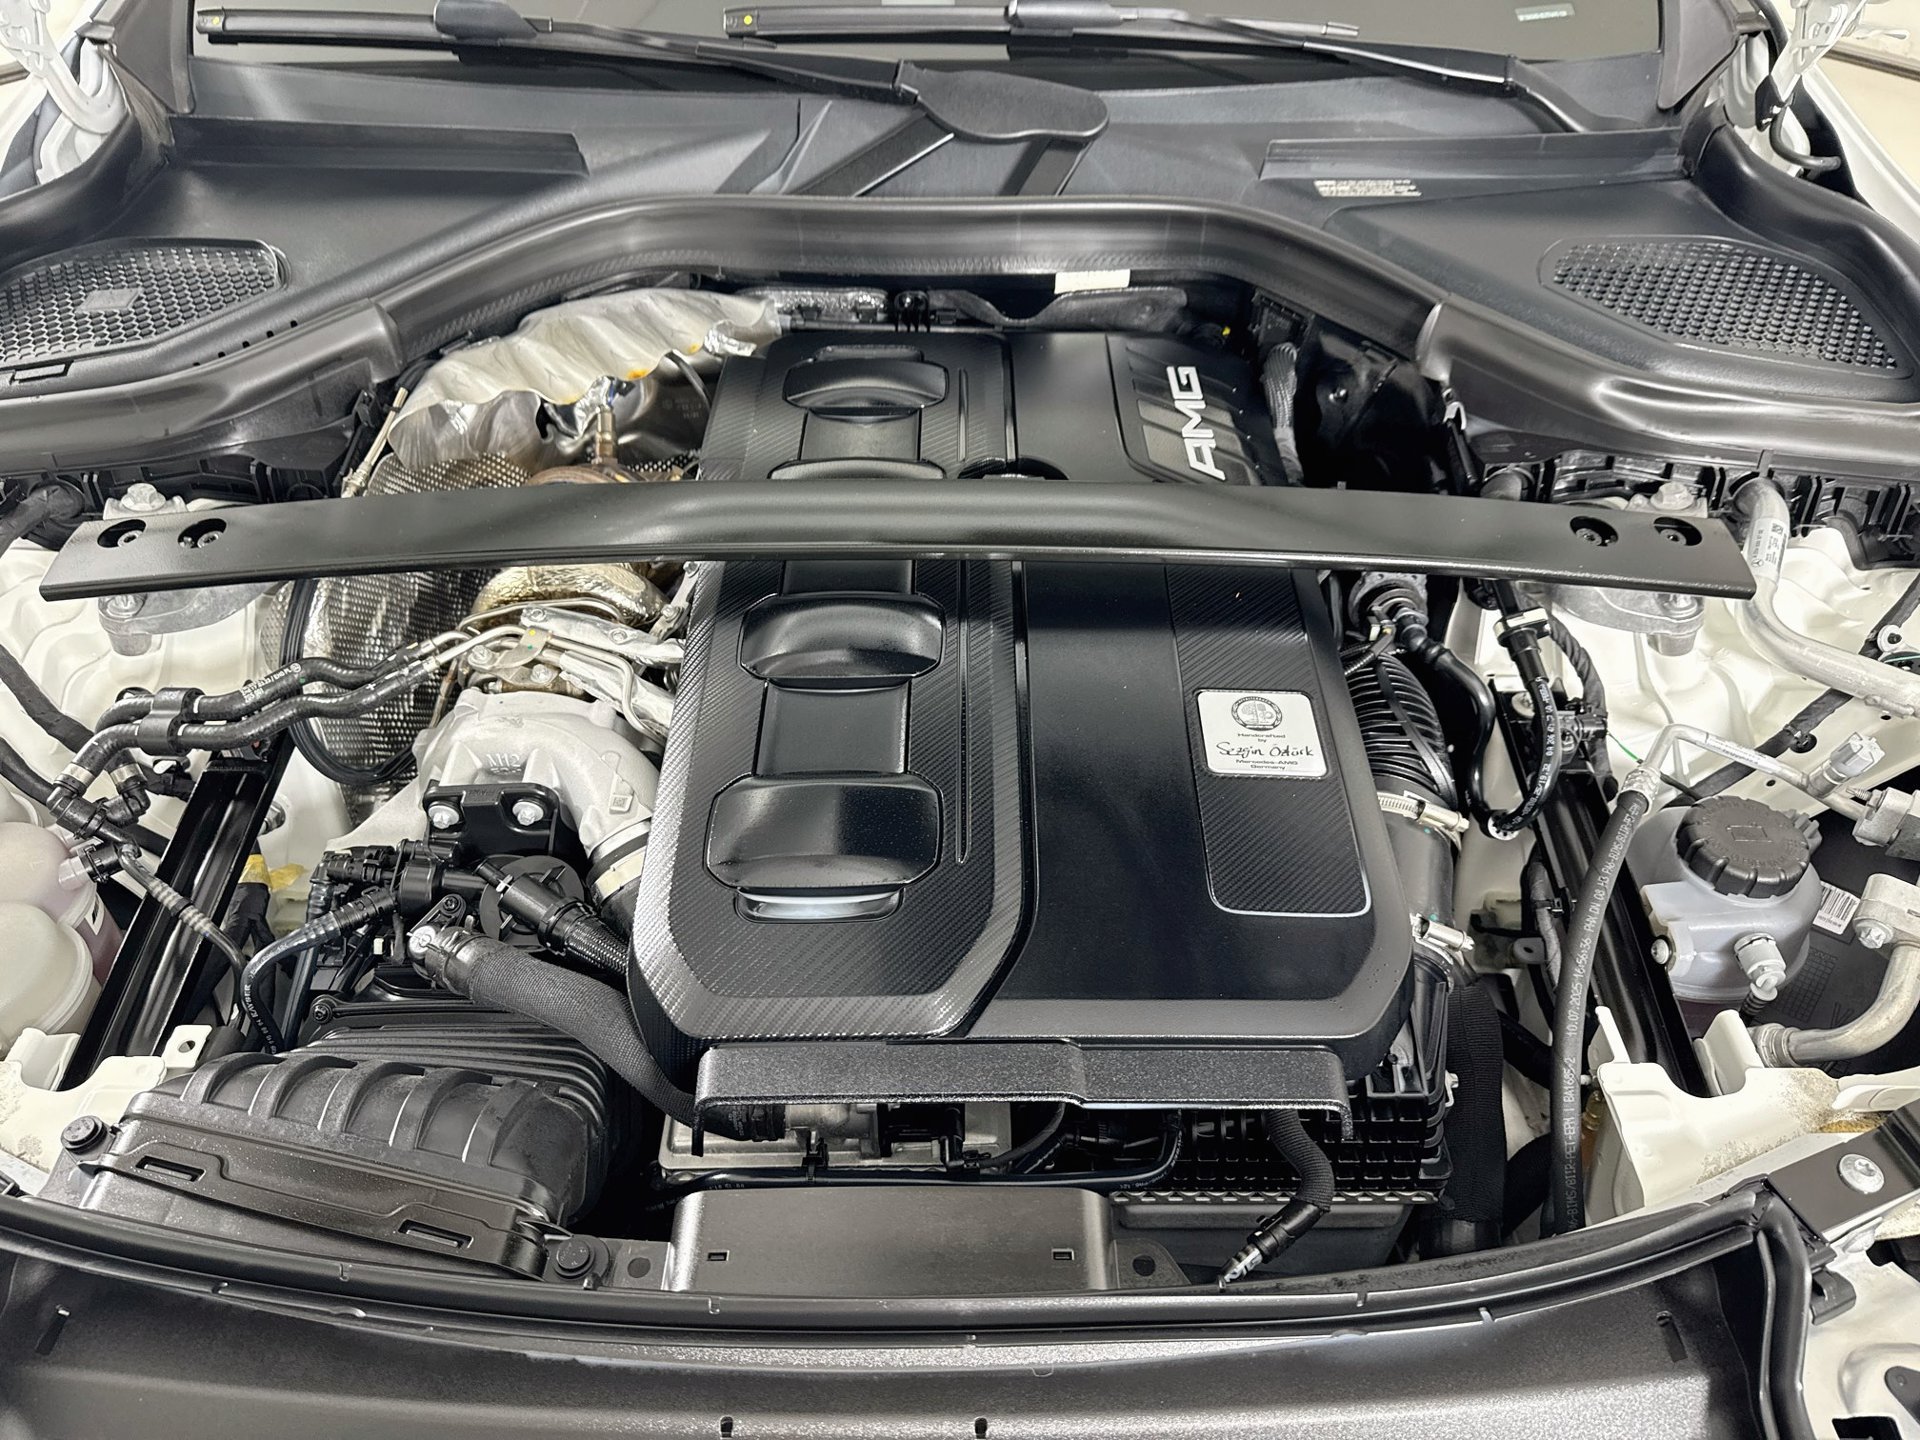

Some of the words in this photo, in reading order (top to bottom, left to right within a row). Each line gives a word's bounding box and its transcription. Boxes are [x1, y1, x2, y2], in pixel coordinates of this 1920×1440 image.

[1166, 366, 1226, 481] AMG
[1573, 937, 1593, 979] 16:56:36
[243, 983, 259, 1018] KAYSER
[1566, 981, 1583, 1038] 10.07.2025
